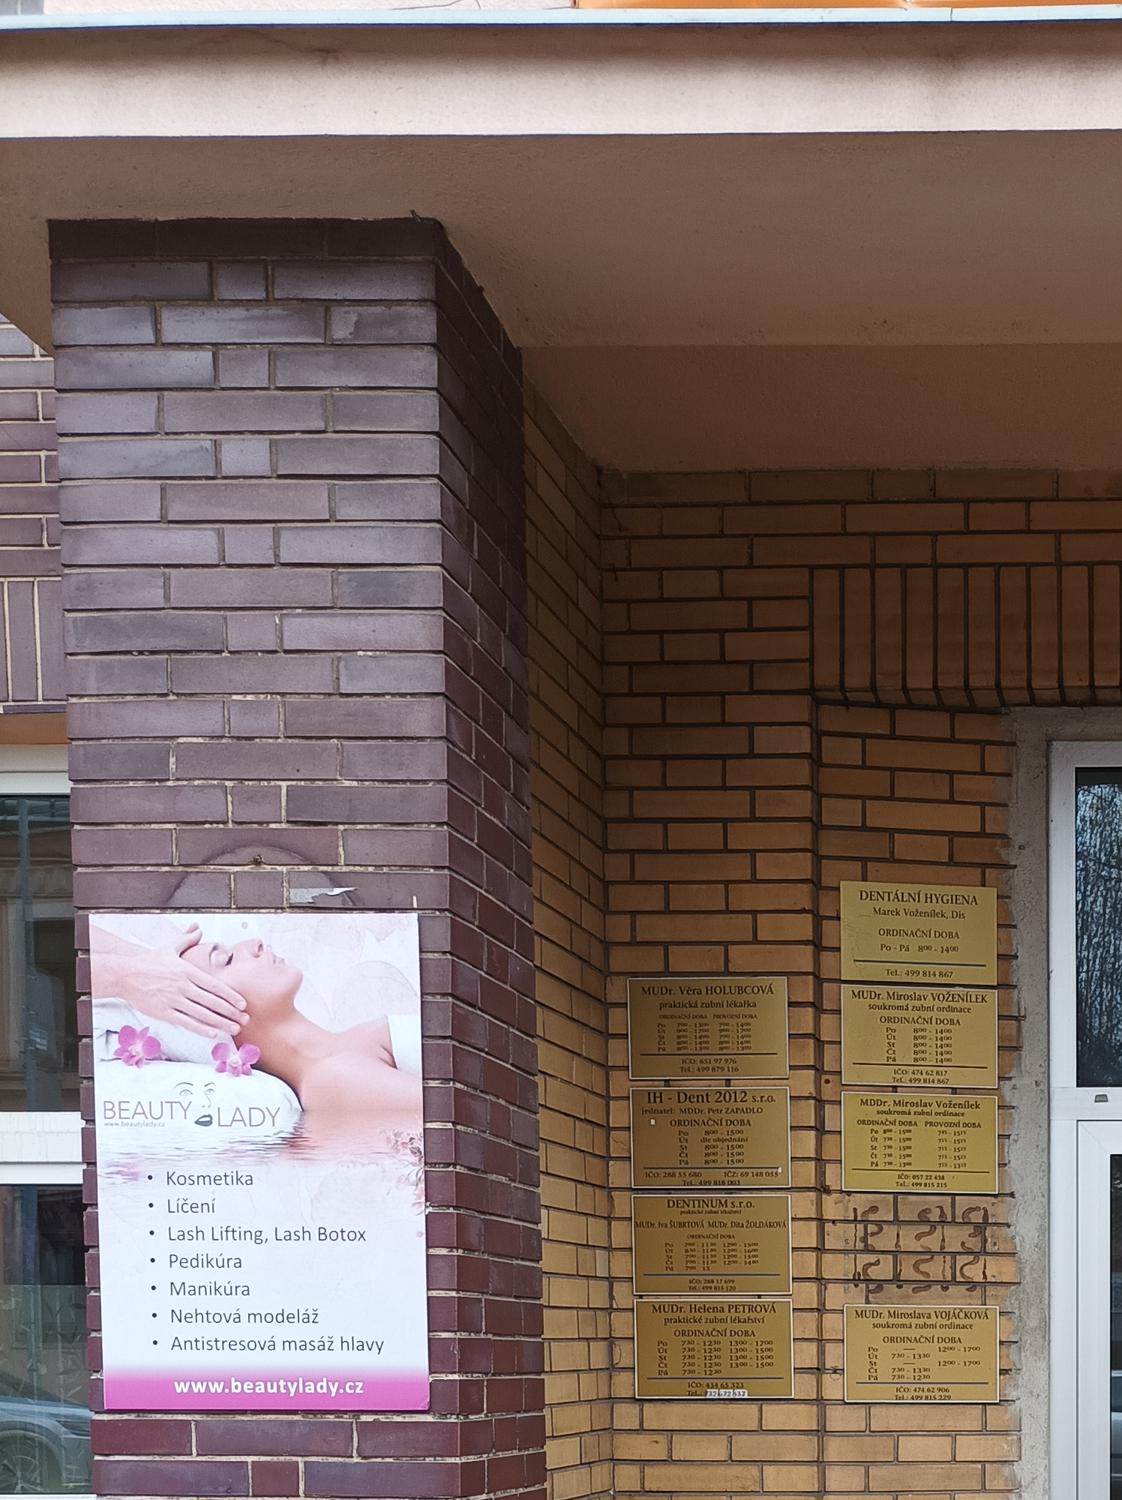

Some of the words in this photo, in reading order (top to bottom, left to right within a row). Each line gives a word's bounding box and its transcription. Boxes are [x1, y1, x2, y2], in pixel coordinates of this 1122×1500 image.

[859, 889, 922, 903] DENTÁLNÍ
[925, 894, 978, 905] HYGIENA
[873, 907, 900, 916] Marek
[904, 908, 948, 919] Voženílek,
[951, 910, 965, 919] Dis
[879, 928, 932, 938] ORDINAČNÍ
[934, 931, 959, 939] DOBA
[641, 986, 675, 996] MUDr.
[705, 983, 774, 995] HOLUBCOVÁ
[851, 990, 883, 1000] MUDr.
[887, 991, 928, 1002] Miroslav
[931, 991, 987, 1003] VOŽENÍLEK
[659, 1001, 698, 1010] praktická
[700, 1000, 724, 1008] zubní
[727, 1000, 756, 1008] lékařka
[868, 1003, 909, 1011] soukromá
[912, 1004, 934, 1012] zubní
[936, 1005, 971, 1013] ordinace
[880, 1016, 933, 1025] ORDINAČNÍ
[648, 1092, 663, 1103] IH
[677, 1092, 711, 1103] Dent
[715, 1091, 747, 1103] 2012
[752, 1095, 775, 1103] s.r.o.
[860, 1099, 890, 1107] MDDr.
[893, 1099, 933, 1108] Miroslav
[936, 1100, 980, 1109] Voženílek
[104, 1101, 192, 1120] BEAUTY
[218, 1107, 280, 1127] LADY
[670, 1118, 723, 1127] ORDINAČNÍ
[166, 1171, 253, 1186] Kosmetika
[167, 1197, 215, 1213] Líčení
[667, 1200, 728, 1208] DENTINUM
[670, 1220, 704, 1228] ŠUBRTOVÁ
[168, 1227, 206, 1242] Lash
[211, 1226, 269, 1245] Lifting,
[274, 1227, 312, 1242] Lash
[318, 1227, 366, 1242] Botox
[169, 1253, 242, 1269] Pedikúra
[170, 1280, 250, 1296] Manikúra
[652, 1304, 686, 1313] MUDr.
[689, 1304, 724, 1313] Helena
[727, 1302, 776, 1313] PETROVÁ
[171, 1308, 242, 1324] Nehtová
[247, 1308, 319, 1324] modeláž
[664, 1316, 702, 1325] praktické
[705, 1316, 728, 1324] zubní
[730, 1316, 764, 1324] lékařství
[855, 1310, 885, 1319] MUDr.
[888, 1310, 931, 1319] Miroslava
[934, 1309, 989, 1321] VOJÁČKOVÁ
[674, 1328, 727, 1337] ORDINAČNÍ
[883, 1335, 934, 1343] ORDINAČNÍ
[171, 1336, 276, 1352] Antistresová
[282, 1336, 334, 1351] masáž
[340, 1336, 384, 1355] hlavy
[174, 1377, 364, 1397] www.beautylady.cz
